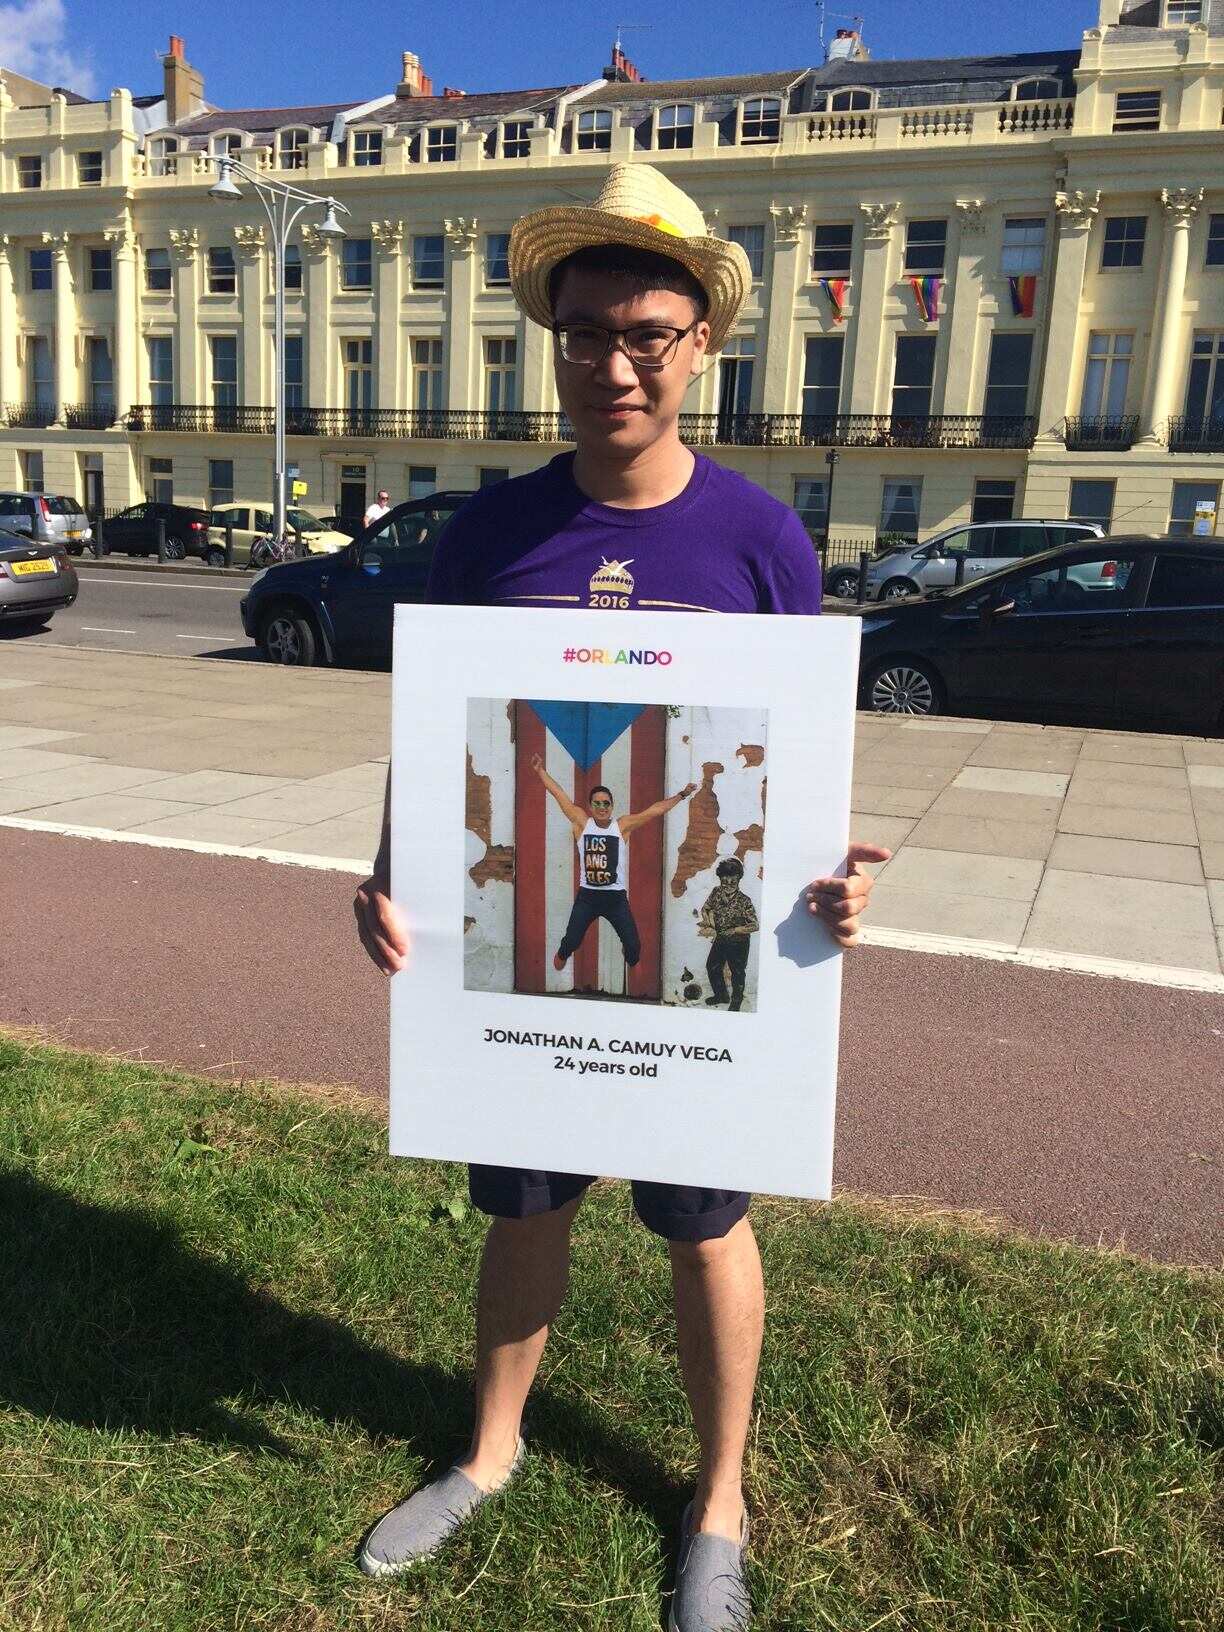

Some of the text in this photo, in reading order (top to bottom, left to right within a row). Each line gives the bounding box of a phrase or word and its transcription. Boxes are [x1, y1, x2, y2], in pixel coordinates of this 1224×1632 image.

[588, 594, 630, 609] 2016
[563, 648, 672, 666] #ORLANDO
[586, 854, 608, 870] ANG
[484, 1029, 733, 1063] JONATHAN A. CAMUY VEGA
[554, 1056, 658, 1078] 24 years old
